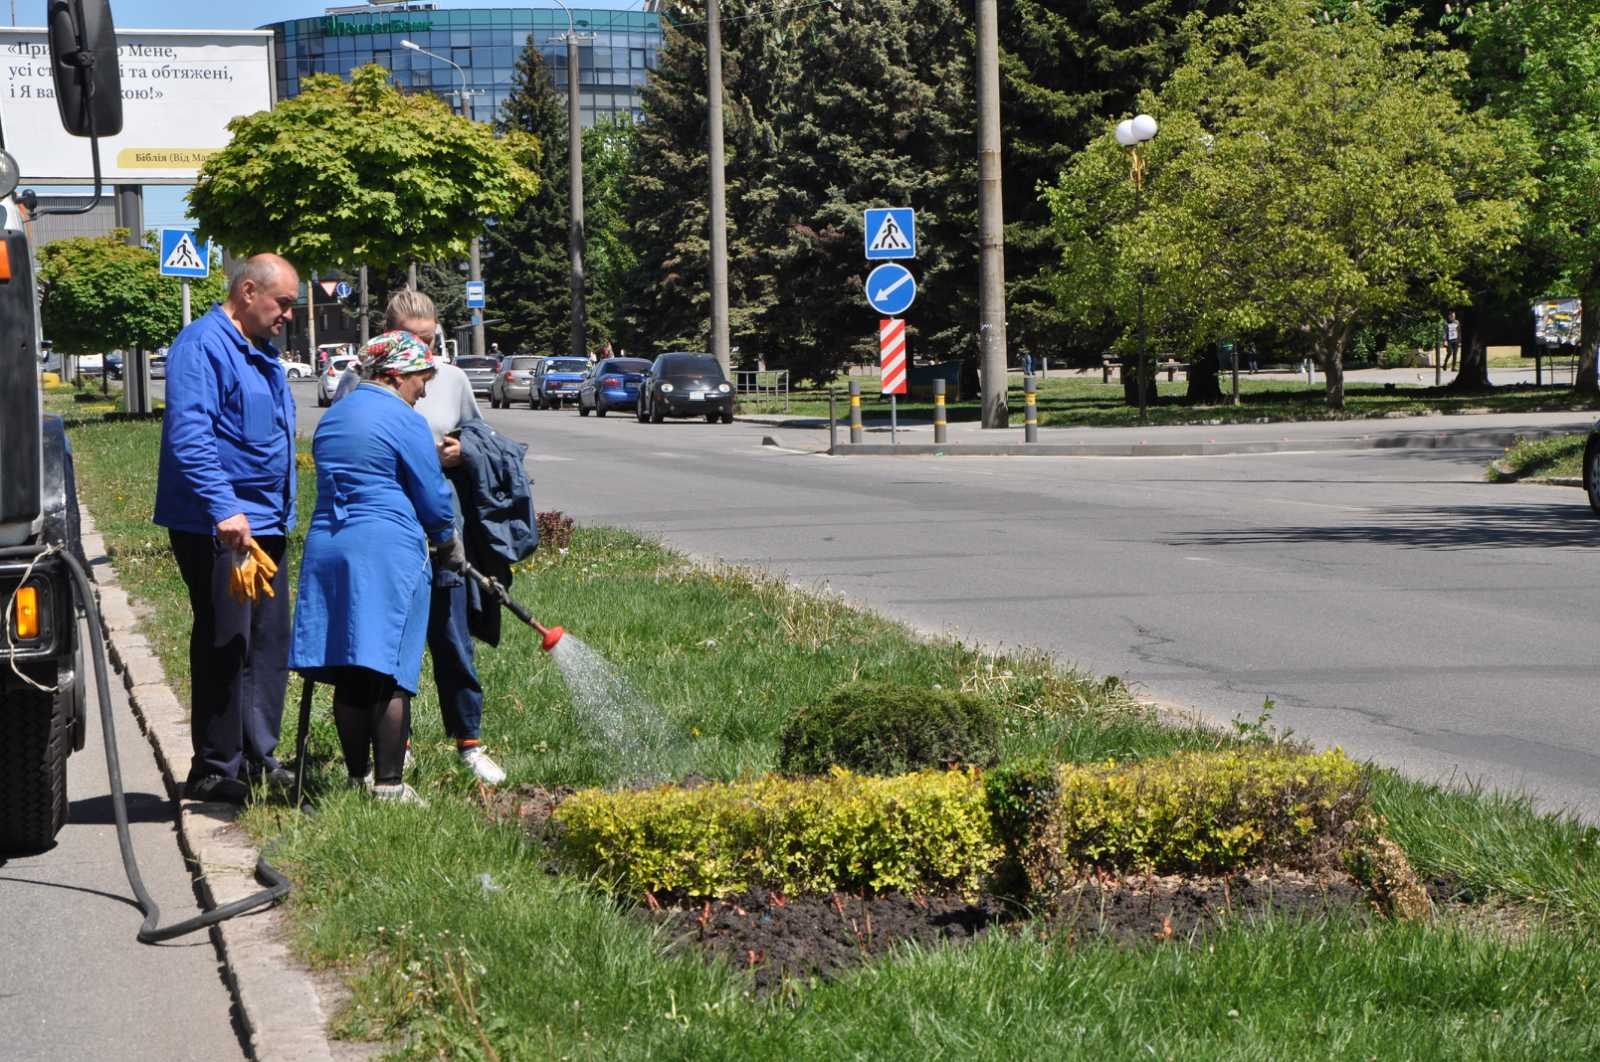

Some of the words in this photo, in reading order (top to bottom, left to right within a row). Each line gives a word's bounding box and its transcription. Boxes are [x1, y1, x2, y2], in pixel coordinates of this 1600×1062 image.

[128, 43, 177, 59] Мене,
[9, 62, 32, 80] усі
[128, 67, 148, 78] та
[151, 64, 233, 82] обтяжені,
[20, 85, 31, 98] Я
[135, 153, 167, 162] Біблія
